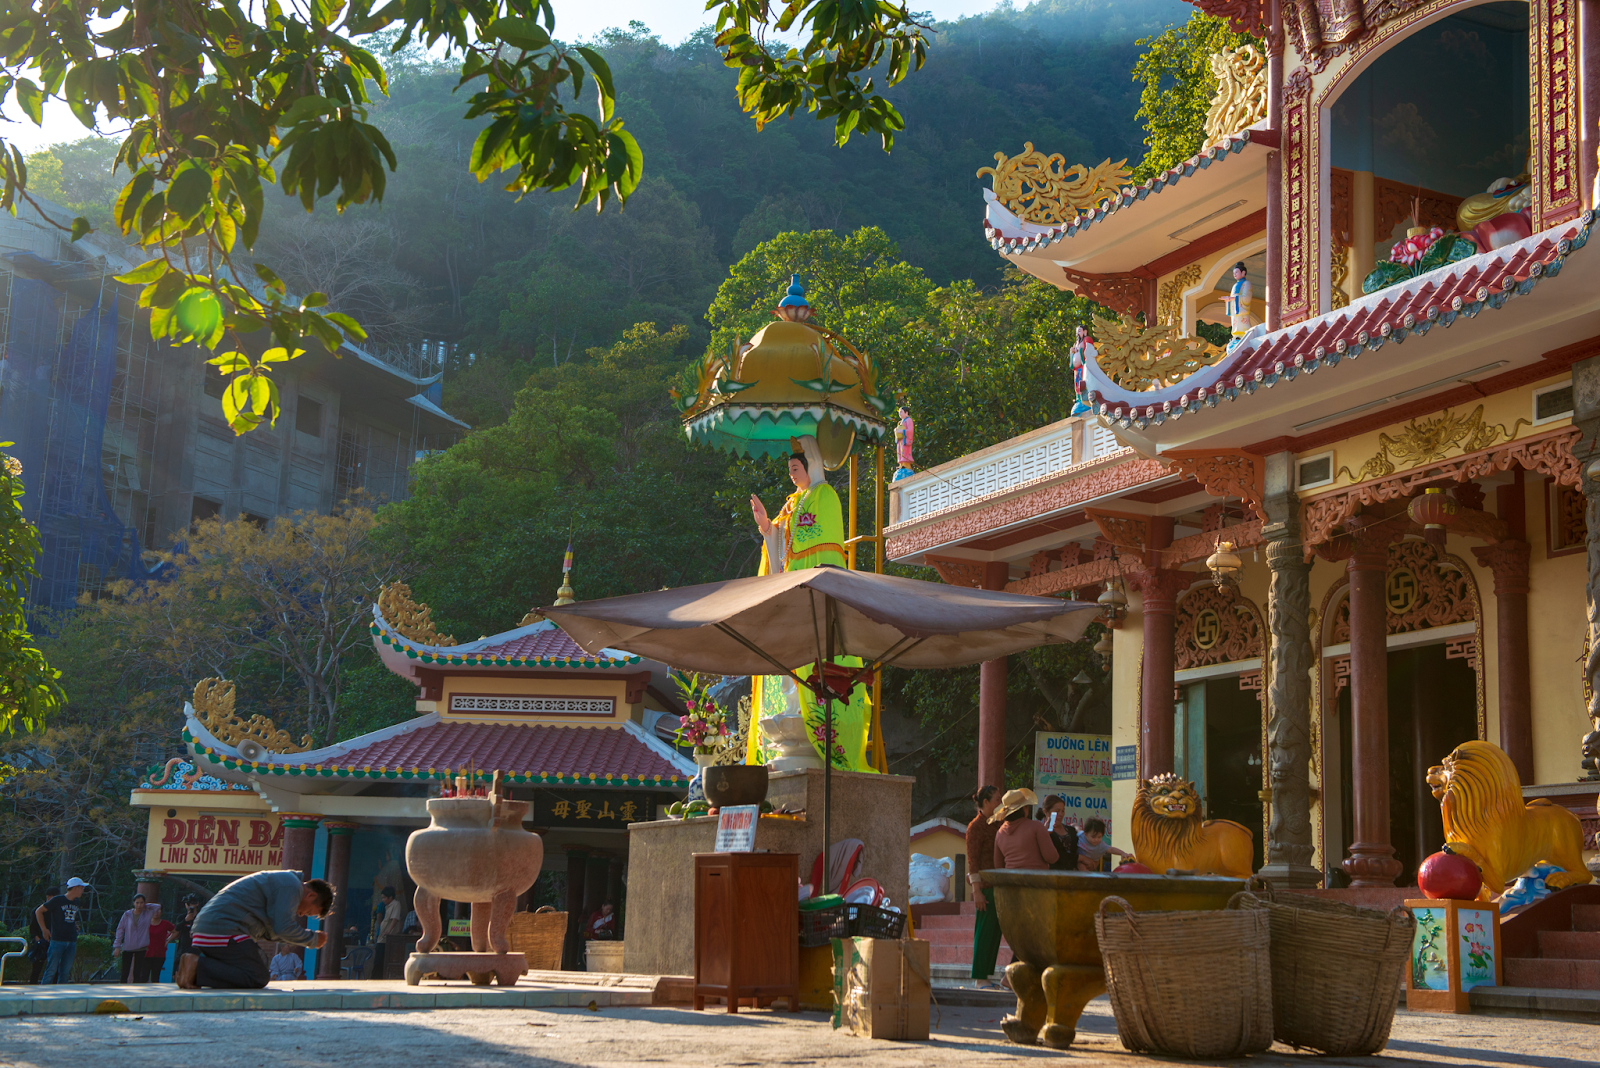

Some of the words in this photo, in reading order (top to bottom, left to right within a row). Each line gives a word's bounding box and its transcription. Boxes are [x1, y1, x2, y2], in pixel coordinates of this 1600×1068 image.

[1047, 735, 1085, 751] ĐƯỜNG
[1088, 737, 1109, 752] LÊN
[1085, 797, 1107, 809] QUA
[223, 845, 263, 865] THÁNH
